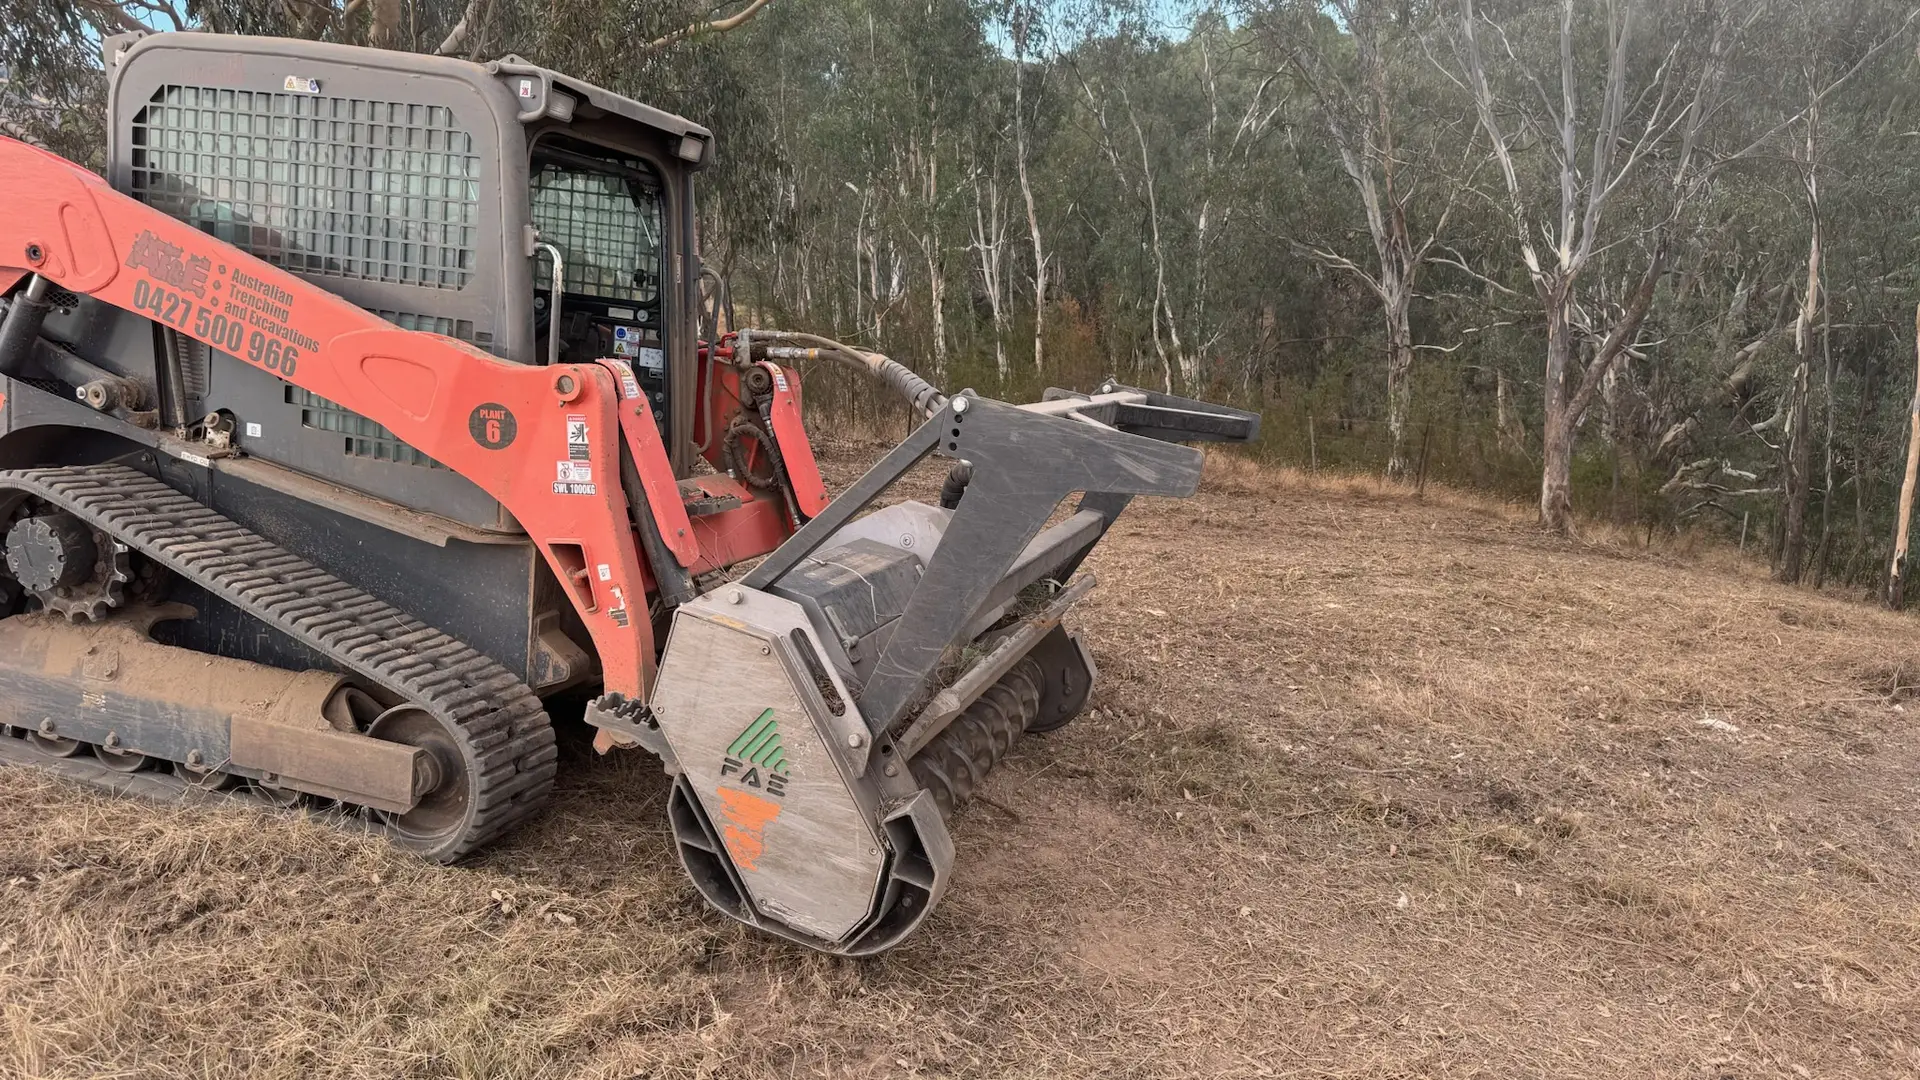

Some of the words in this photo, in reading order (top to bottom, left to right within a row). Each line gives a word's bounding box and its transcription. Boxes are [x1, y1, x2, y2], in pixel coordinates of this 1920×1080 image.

[229, 284, 290, 323] Trenching
[231, 268, 294, 307] Australian
[133, 279, 192, 328] 0427
[194, 306, 244, 352] 500
[247, 331, 299, 377] 966
[224, 302, 248, 321] and
[249, 311, 320, 353] Excavations
[480, 409, 506, 420] PLANT
[486, 420, 501, 443] 6
[553, 483, 569, 494] SWL
[570, 484, 596, 495] 1000KG
[721, 757, 789, 797] FAE
